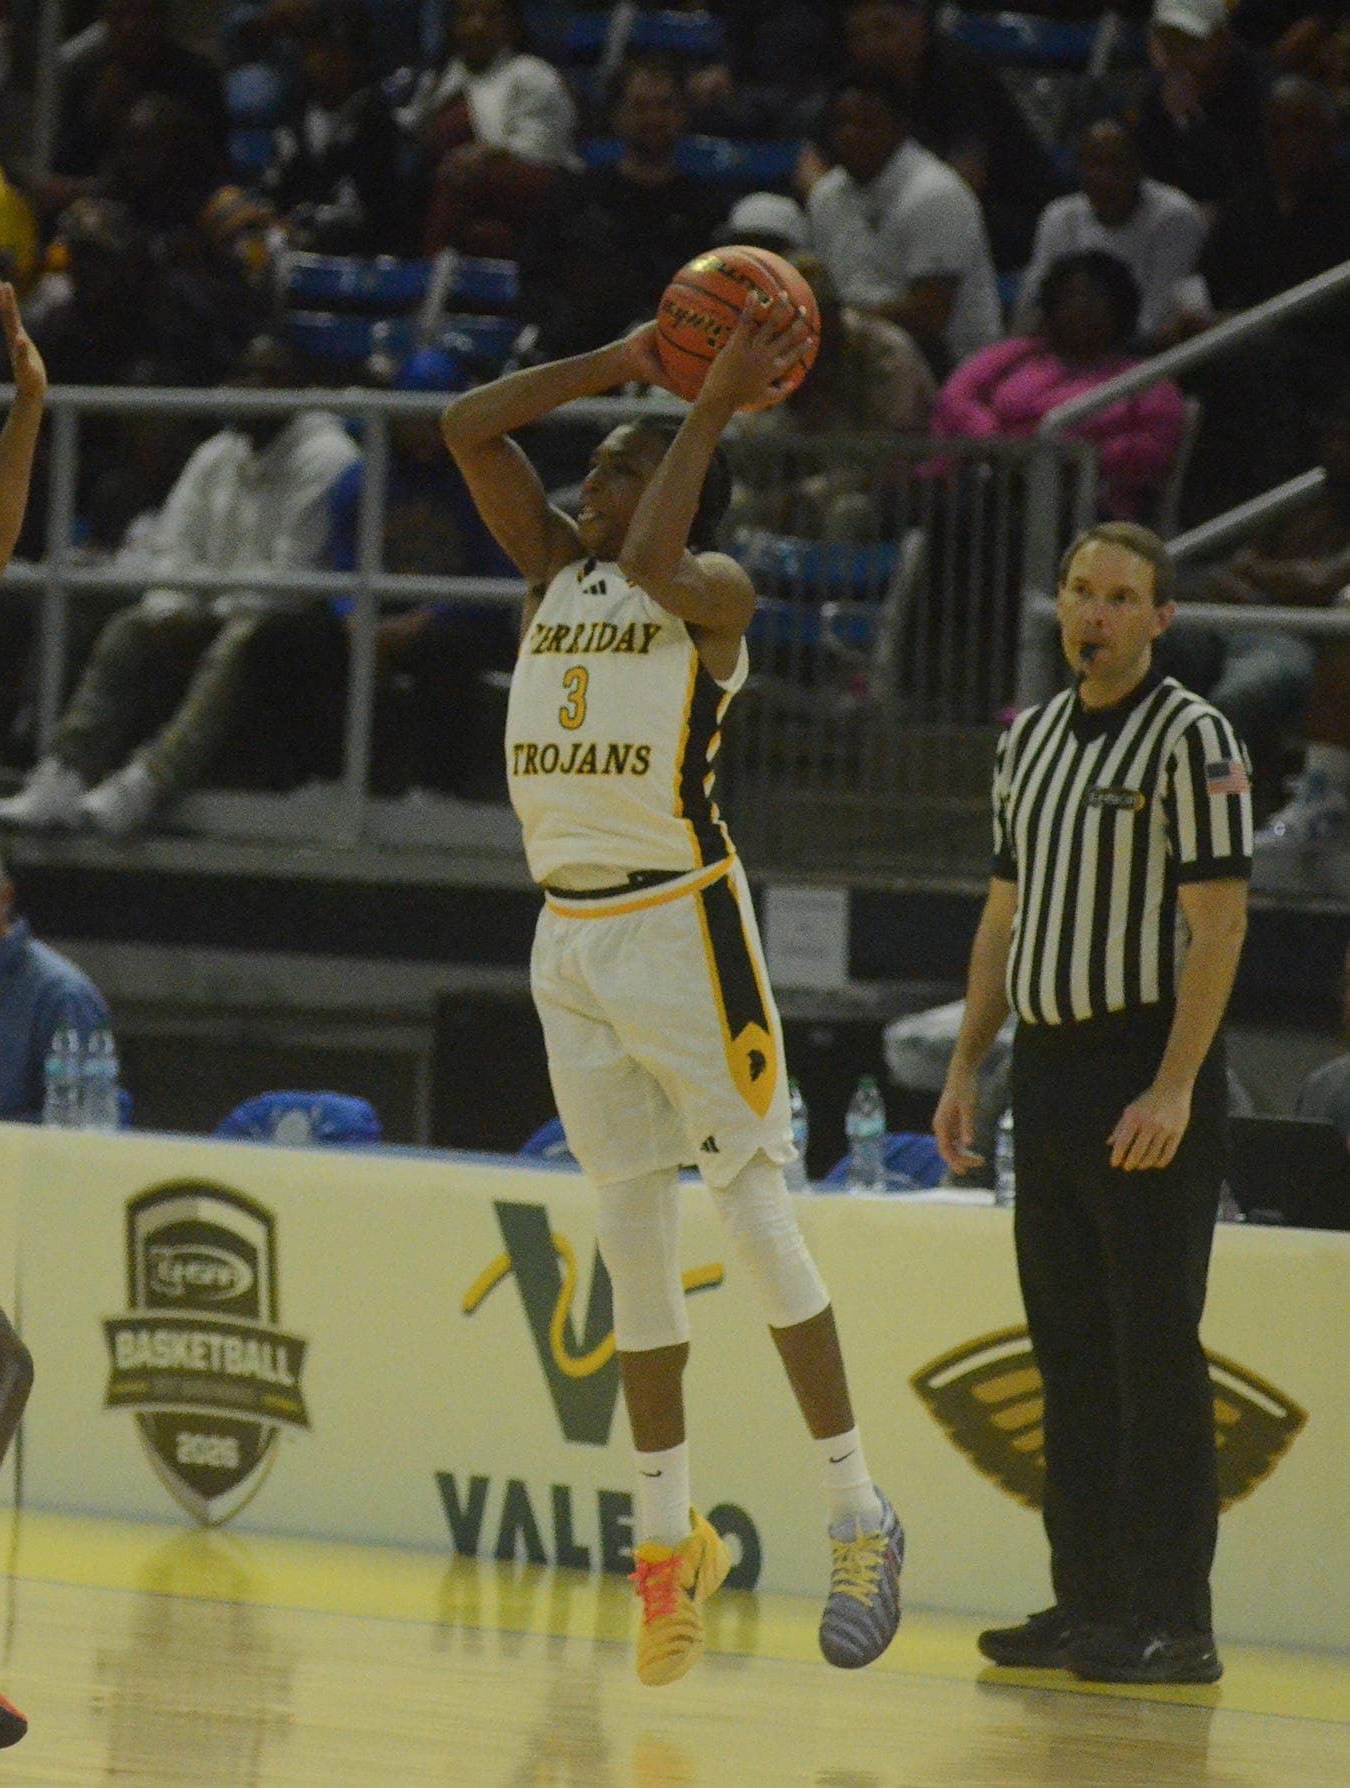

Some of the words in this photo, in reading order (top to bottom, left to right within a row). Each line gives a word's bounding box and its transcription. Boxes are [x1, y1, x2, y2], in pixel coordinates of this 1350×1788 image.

[558, 664, 590, 731] 3
[513, 742, 652, 776] TROJANS
[115, 1328, 295, 1387] BASKETBALL
[434, 1471, 762, 1592] VALEO
